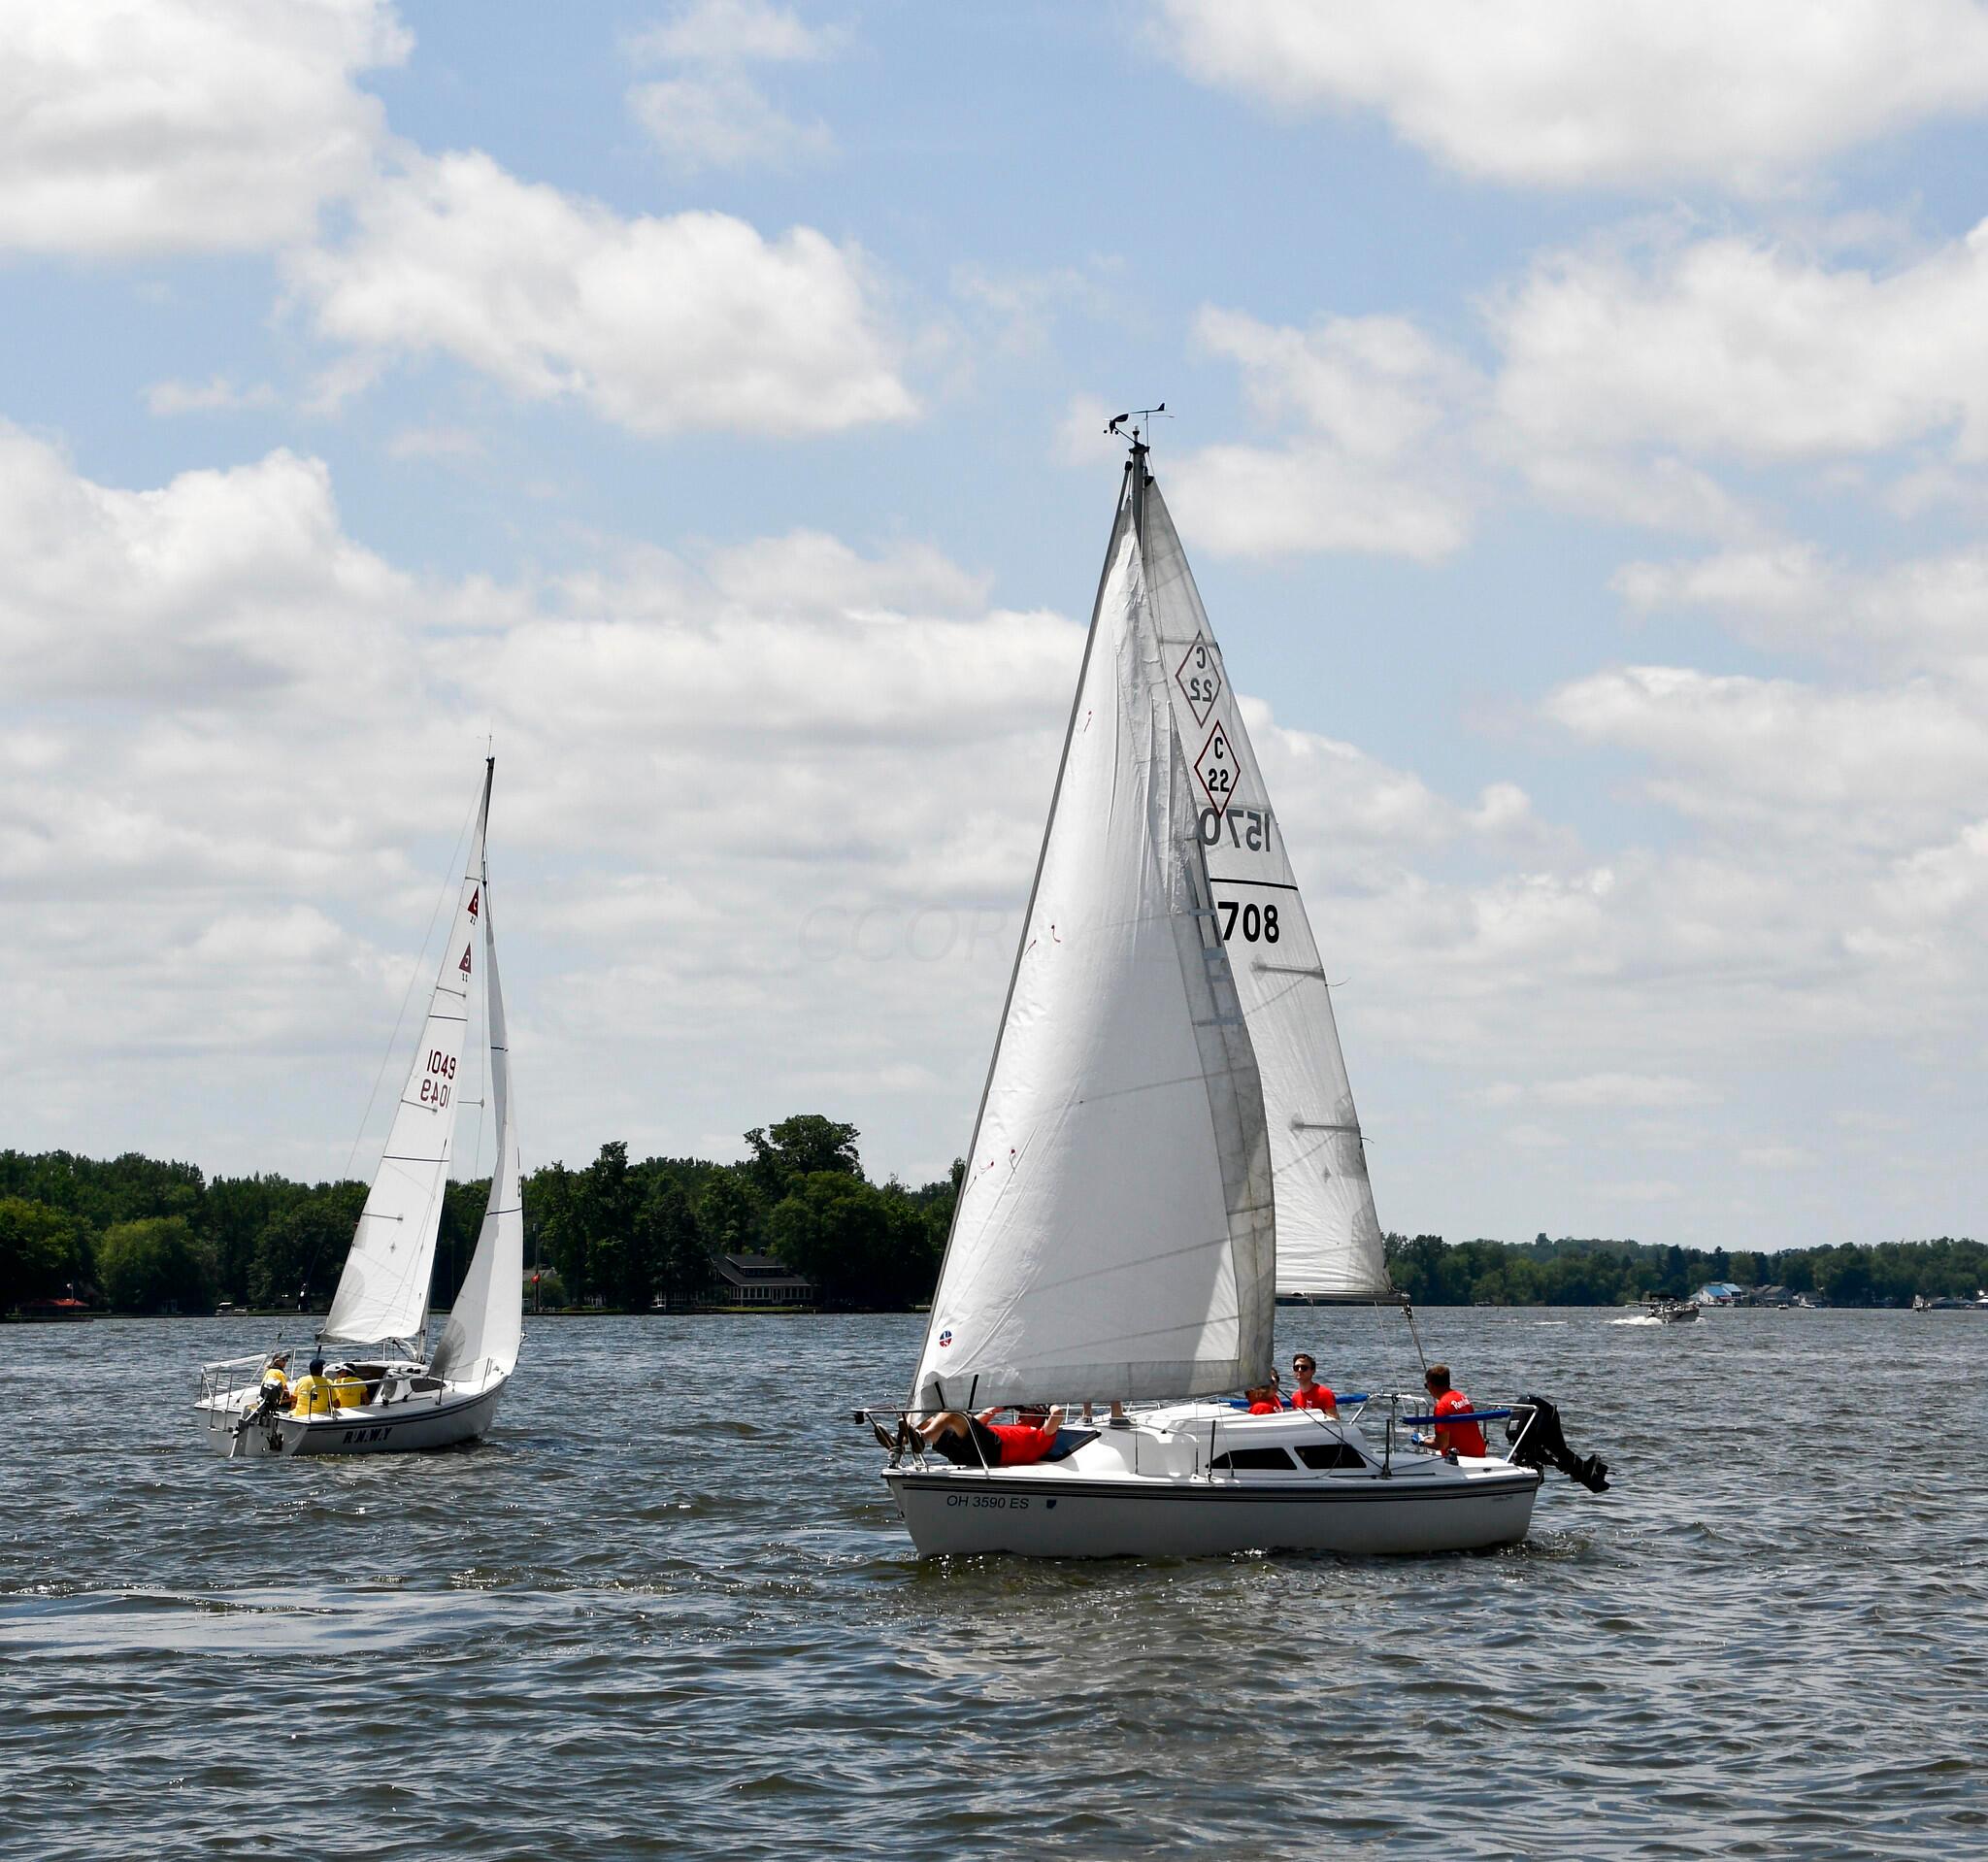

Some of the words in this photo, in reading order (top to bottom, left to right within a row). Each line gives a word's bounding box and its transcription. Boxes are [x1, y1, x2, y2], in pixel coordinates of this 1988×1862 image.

[1214, 737, 1224, 759] C
[1208, 769, 1230, 792] 22
[1217, 901, 1279, 944] 708
[427, 1049, 456, 1080] 1049
[946, 1495, 969, 1507] OH
[972, 1496, 1006, 1509] 3590
[1010, 1498, 1029, 1509] ES
